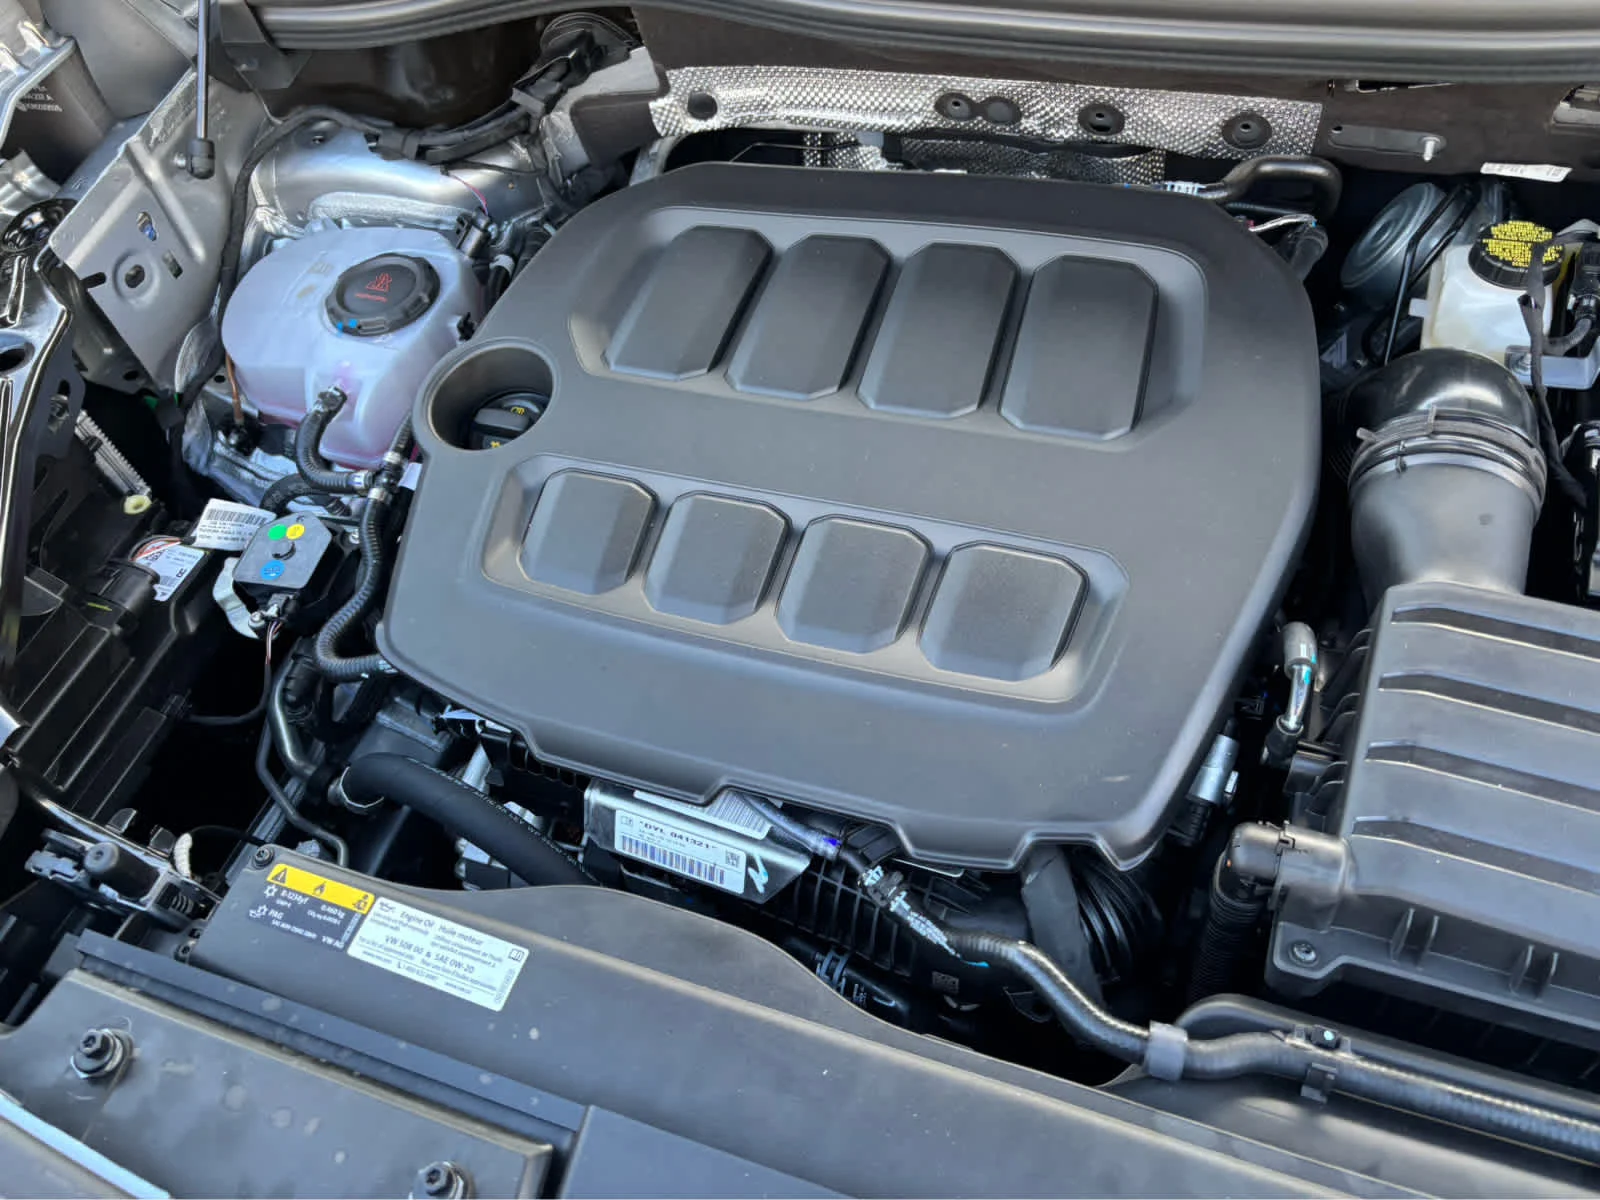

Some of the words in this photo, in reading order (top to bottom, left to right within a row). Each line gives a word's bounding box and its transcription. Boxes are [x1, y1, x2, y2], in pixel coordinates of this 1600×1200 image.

[400, 911, 424, 926] Engine
[423, 918, 435, 929] Oil
[434, 952, 450, 965] SAE
